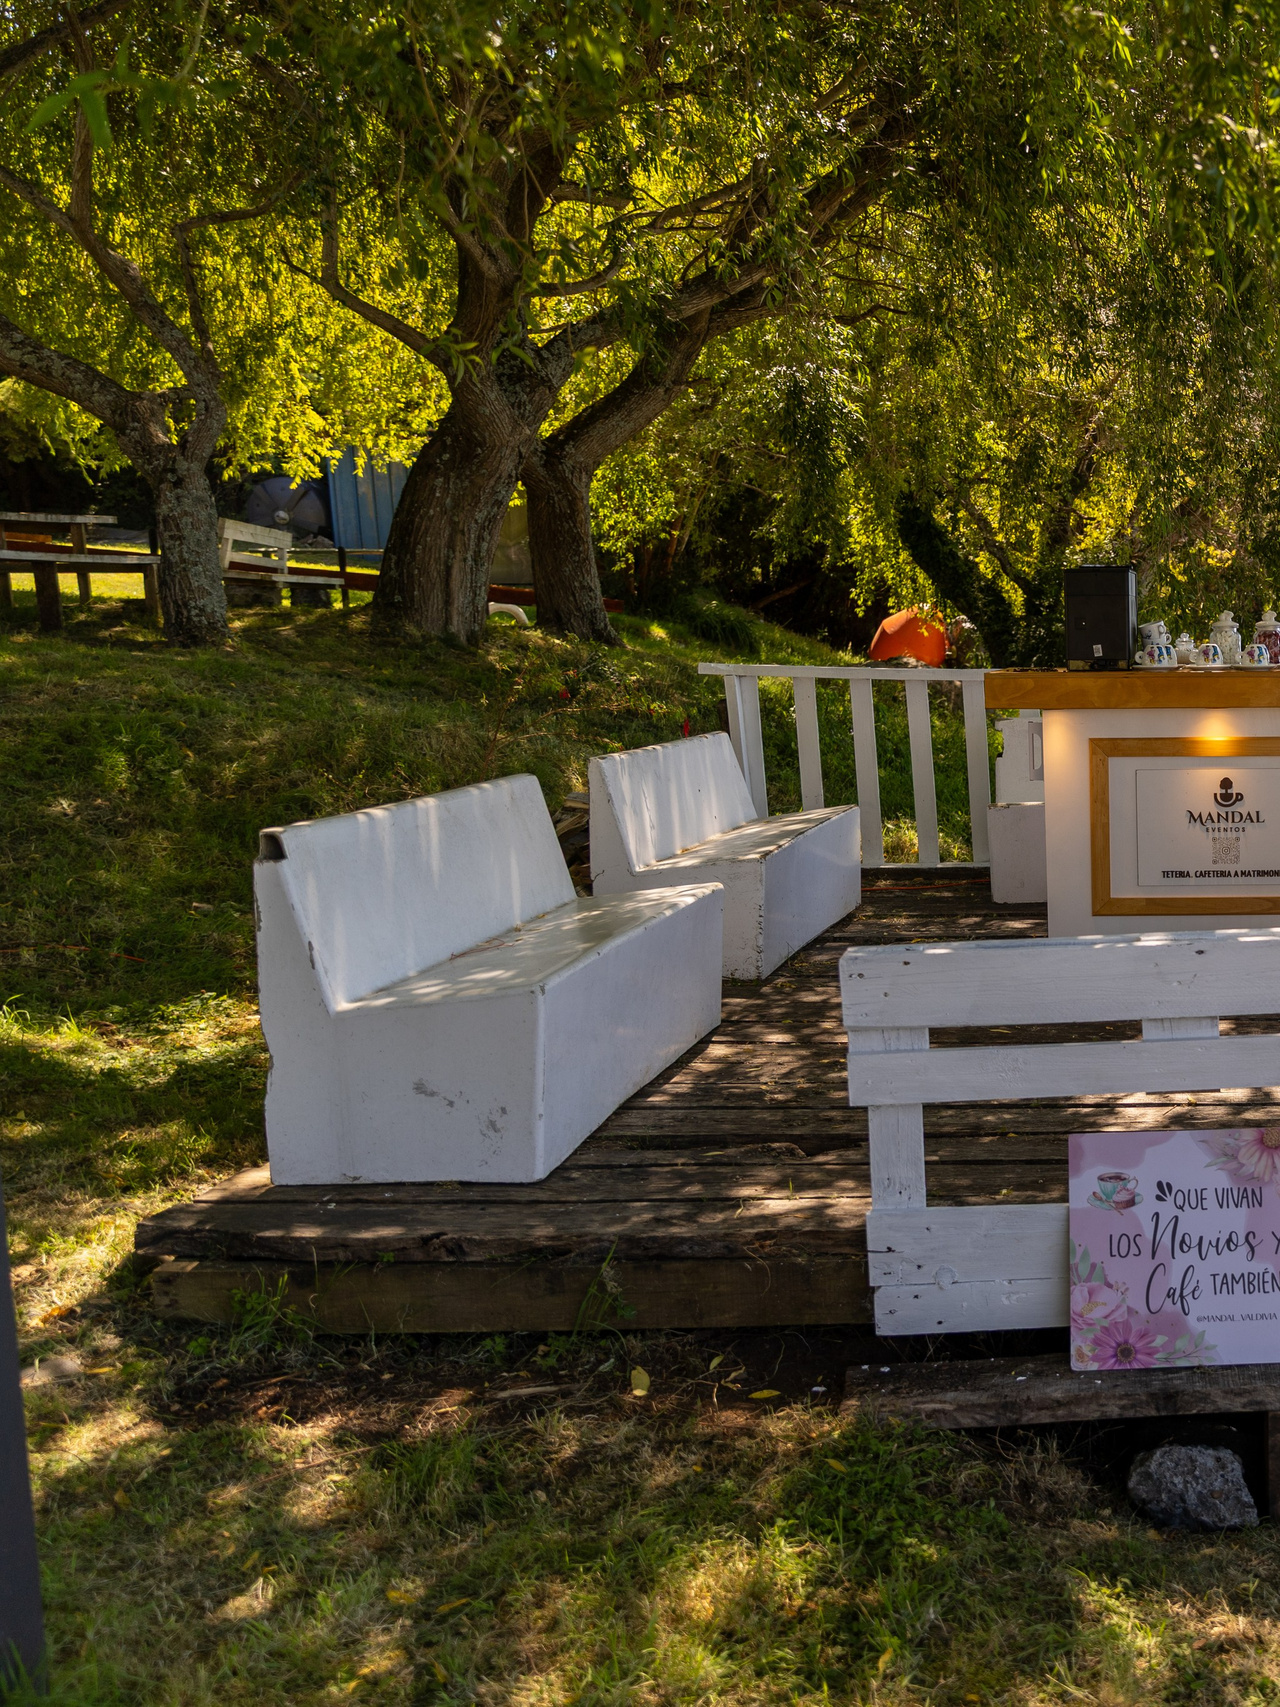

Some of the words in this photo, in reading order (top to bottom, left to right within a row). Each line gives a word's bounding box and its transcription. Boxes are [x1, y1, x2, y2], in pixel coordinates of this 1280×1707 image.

[1186, 809, 1265, 827] MANDAL
[1194, 870, 1232, 878] CAFETERIA
[1233, 870, 1240, 878] A
[1173, 1188, 1209, 1212] QUE
[1215, 1186, 1263, 1209] VIVAN
[1109, 1233, 1142, 1258] LOS
[1150, 1211, 1264, 1262] Novios
[1145, 1263, 1203, 1316] Café
